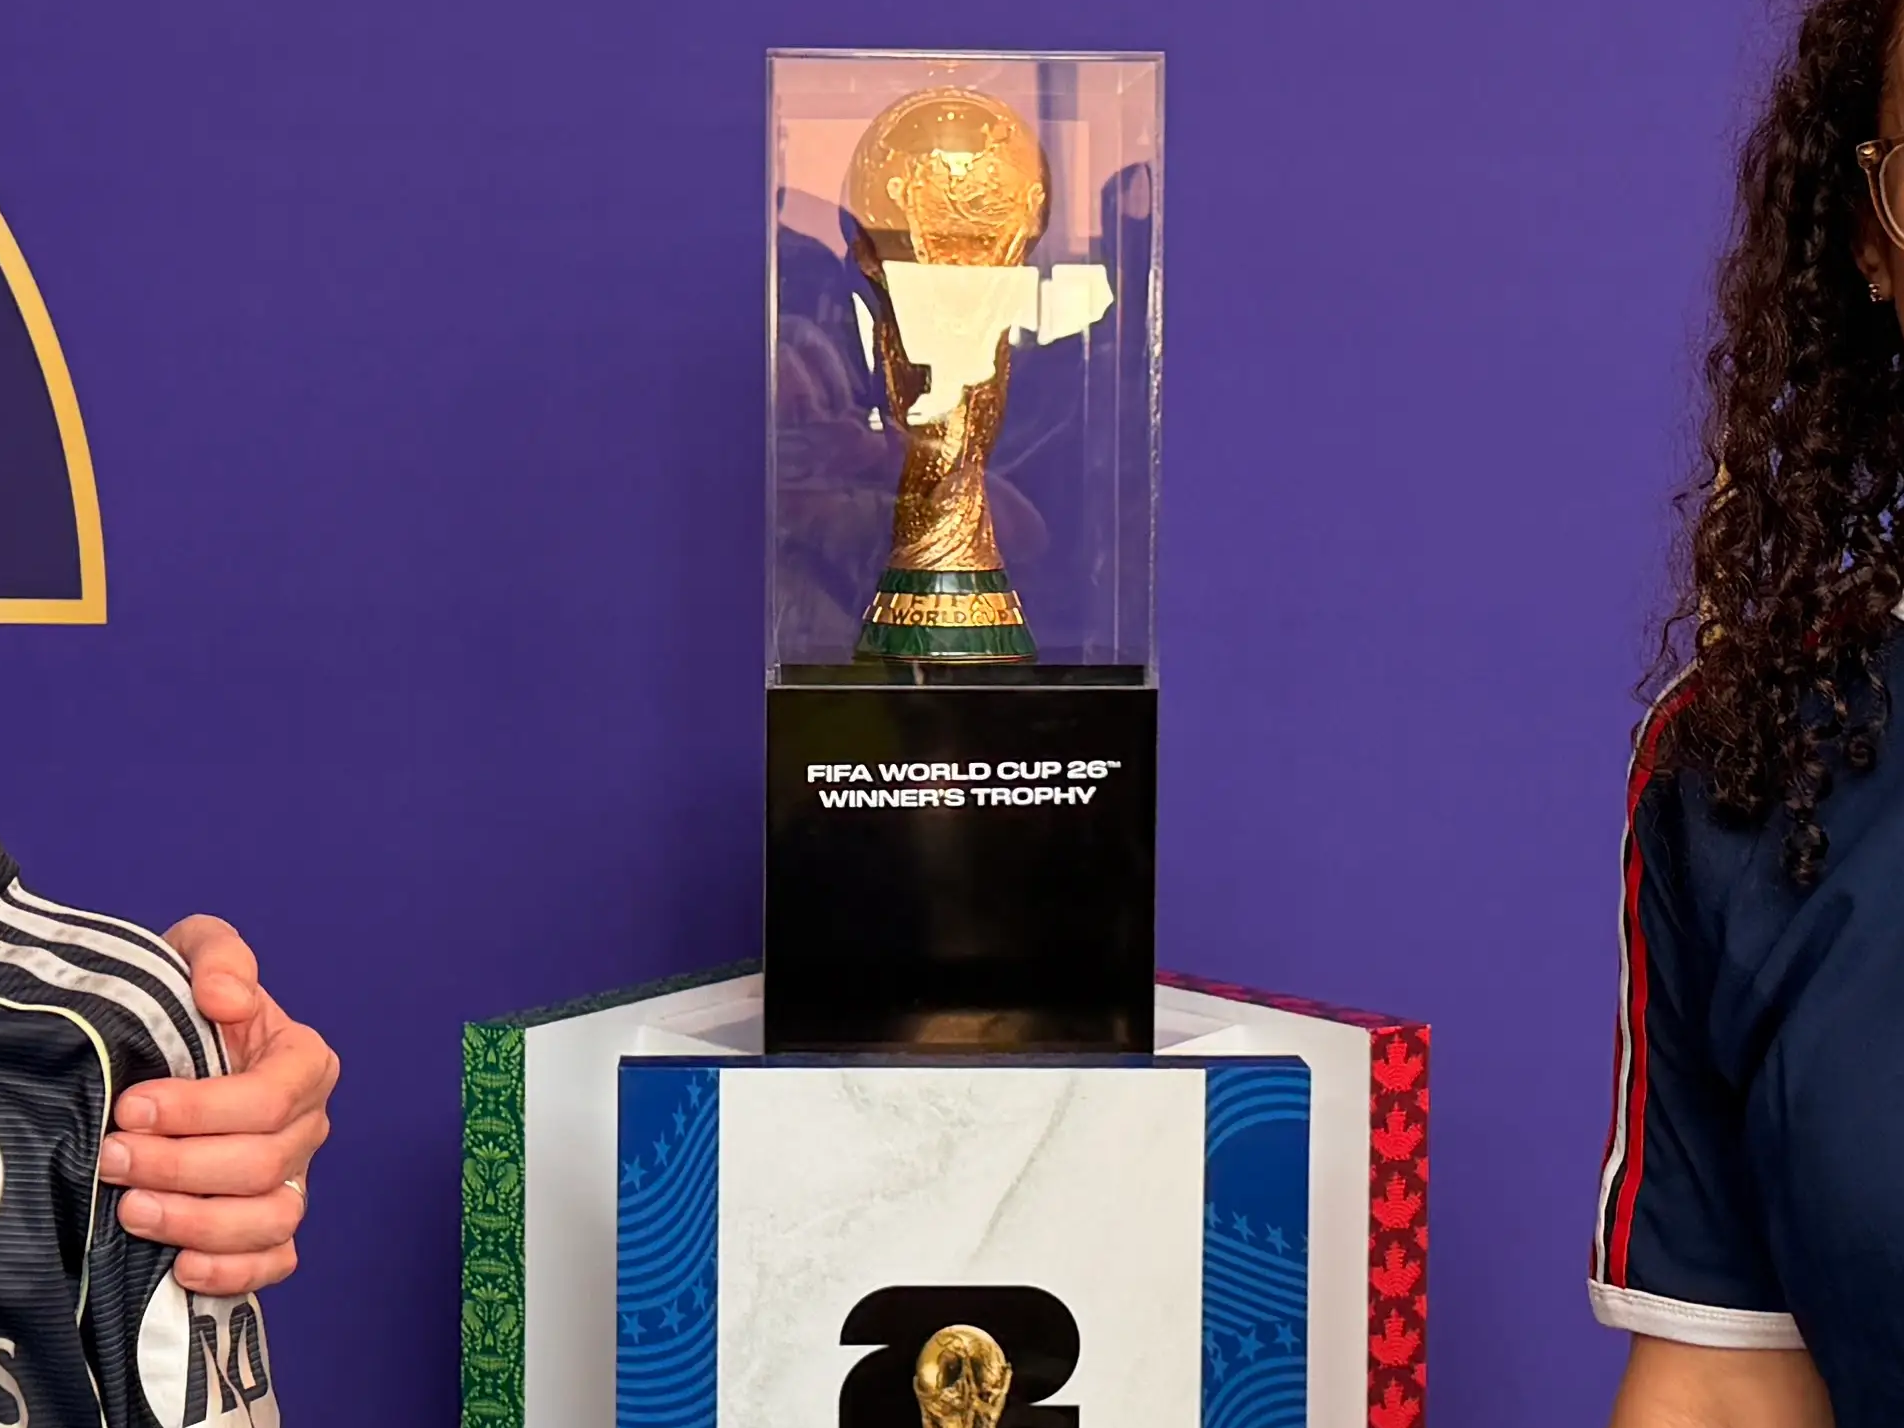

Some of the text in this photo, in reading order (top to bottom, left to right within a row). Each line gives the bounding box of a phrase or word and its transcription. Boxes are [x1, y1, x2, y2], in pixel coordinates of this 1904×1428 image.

[807, 763, 873, 784] FIFA
[878, 762, 992, 783] WORLD
[996, 760, 1063, 781] CUP
[818, 785, 1097, 809] WINNER'S TROPHY
